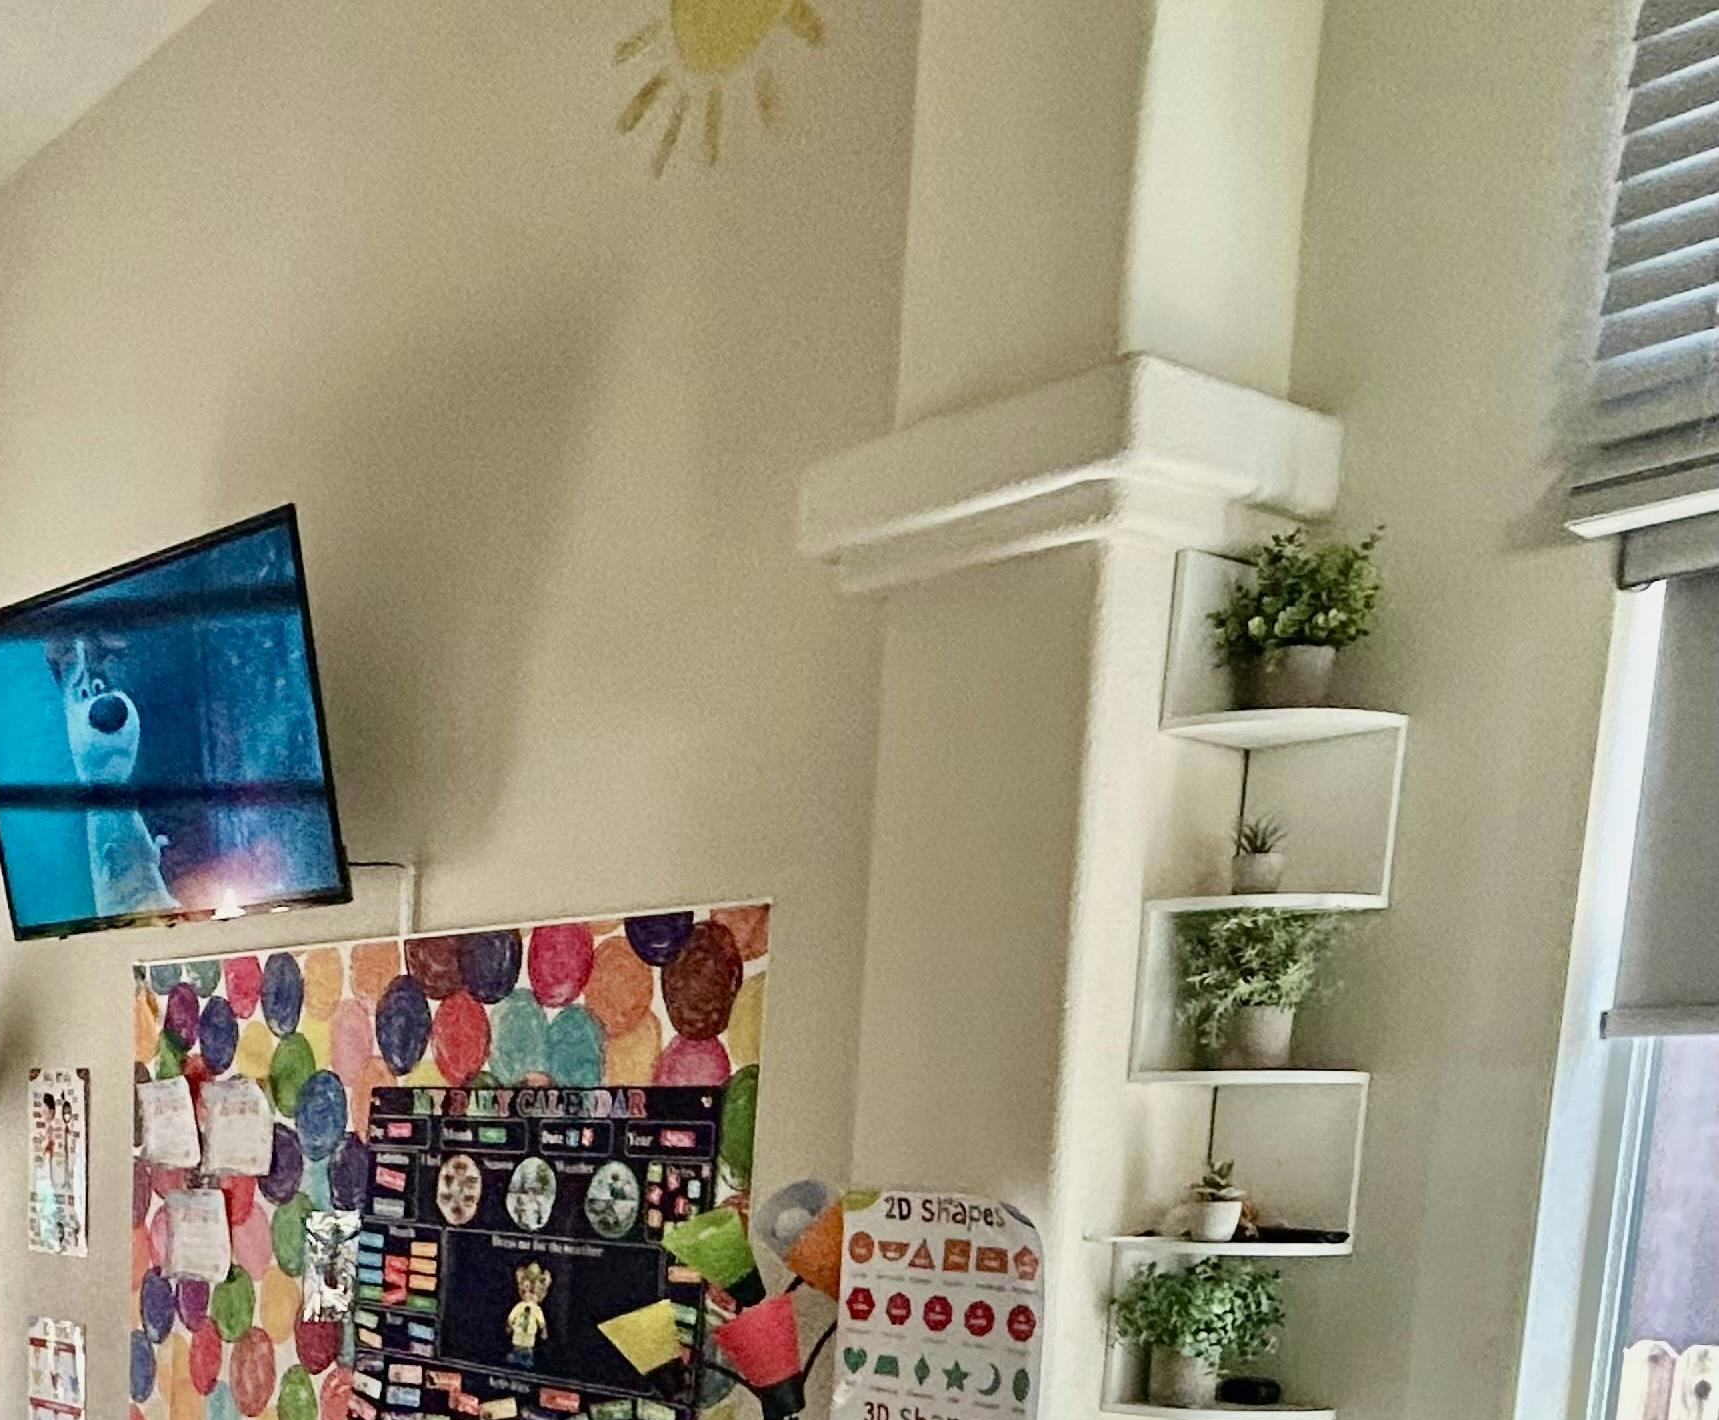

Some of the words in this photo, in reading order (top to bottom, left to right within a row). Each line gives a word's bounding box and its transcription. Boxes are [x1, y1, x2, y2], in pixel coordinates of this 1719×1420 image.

[413, 1088, 447, 1116] MY
[516, 1089, 648, 1119] CALENDAR
[883, 1196, 912, 1221] 2D
[921, 1196, 1006, 1231] Shapes
